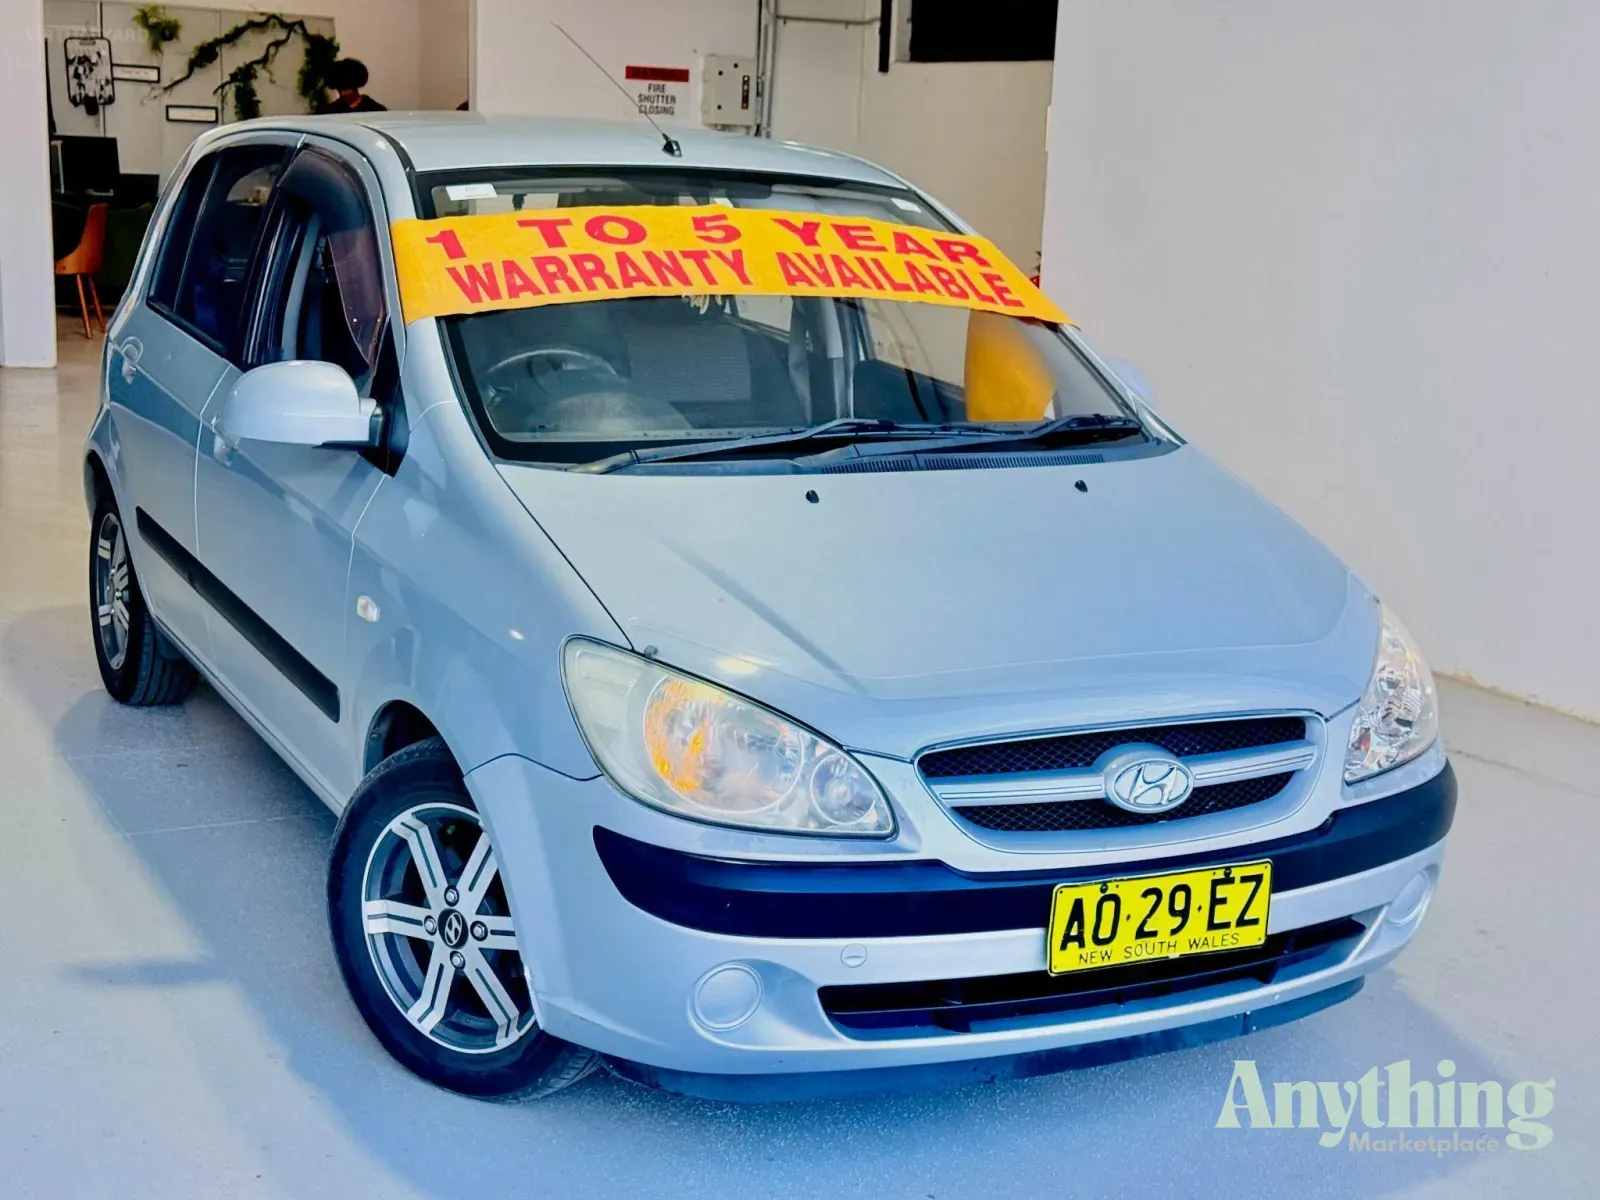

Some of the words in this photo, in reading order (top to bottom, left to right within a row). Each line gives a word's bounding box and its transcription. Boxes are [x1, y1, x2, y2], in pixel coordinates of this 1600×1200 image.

[638, 94, 676, 104] SHUTTER
[648, 83, 666, 93] FIRE
[638, 105, 675, 116] CLOSING
[425, 229, 467, 260] 1
[516, 214, 648, 249] TO
[691, 213, 742, 244] 5
[769, 217, 993, 268] YEAR
[445, 248, 753, 304] WARRANTY
[775, 251, 1026, 308] AVAILABLE
[1079, 949, 1114, 965] NEW
[1124, 940, 1177, 959] SOUTH
[1188, 932, 1240, 950] WALES
